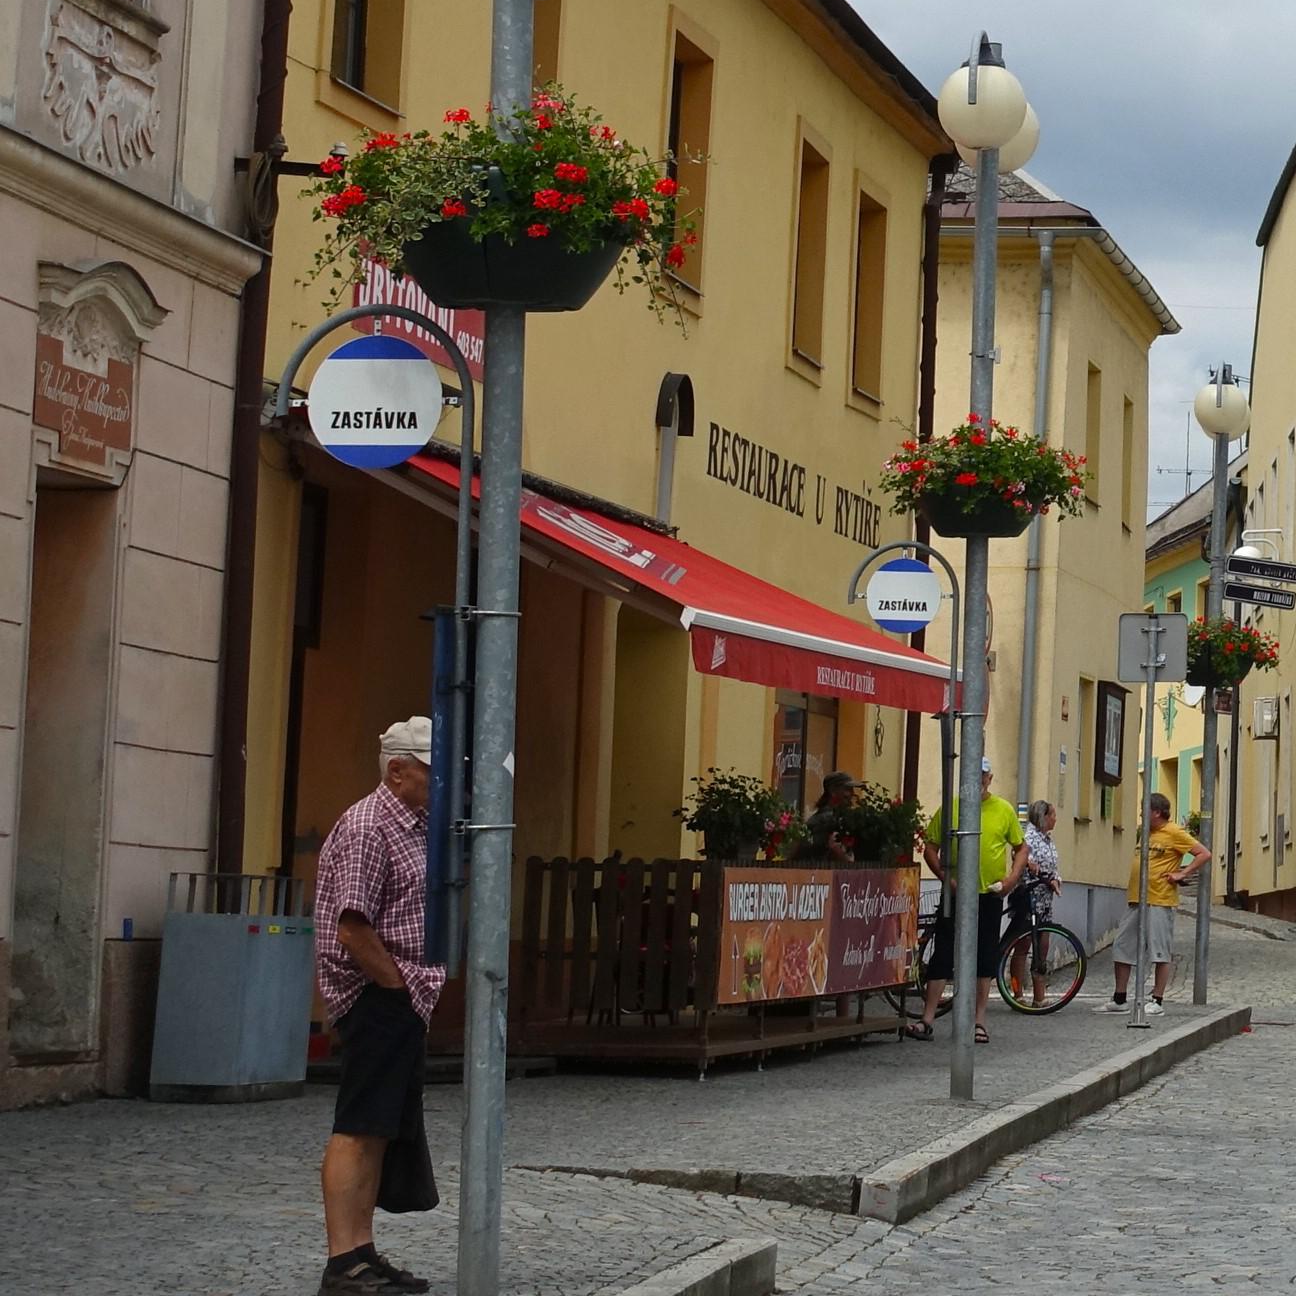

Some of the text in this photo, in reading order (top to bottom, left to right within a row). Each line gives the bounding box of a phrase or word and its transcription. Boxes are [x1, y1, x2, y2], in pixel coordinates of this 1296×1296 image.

[331, 407, 418, 429] ZASTÁVKA
[707, 422, 881, 550] RESTAURACE U RYTÍŘE
[878, 599, 928, 612] ZASTÁVKA
[817, 666, 850, 690] RESTAURACE
[730, 883, 759, 921] BURGER
[760, 883, 787, 921] BISTRO
